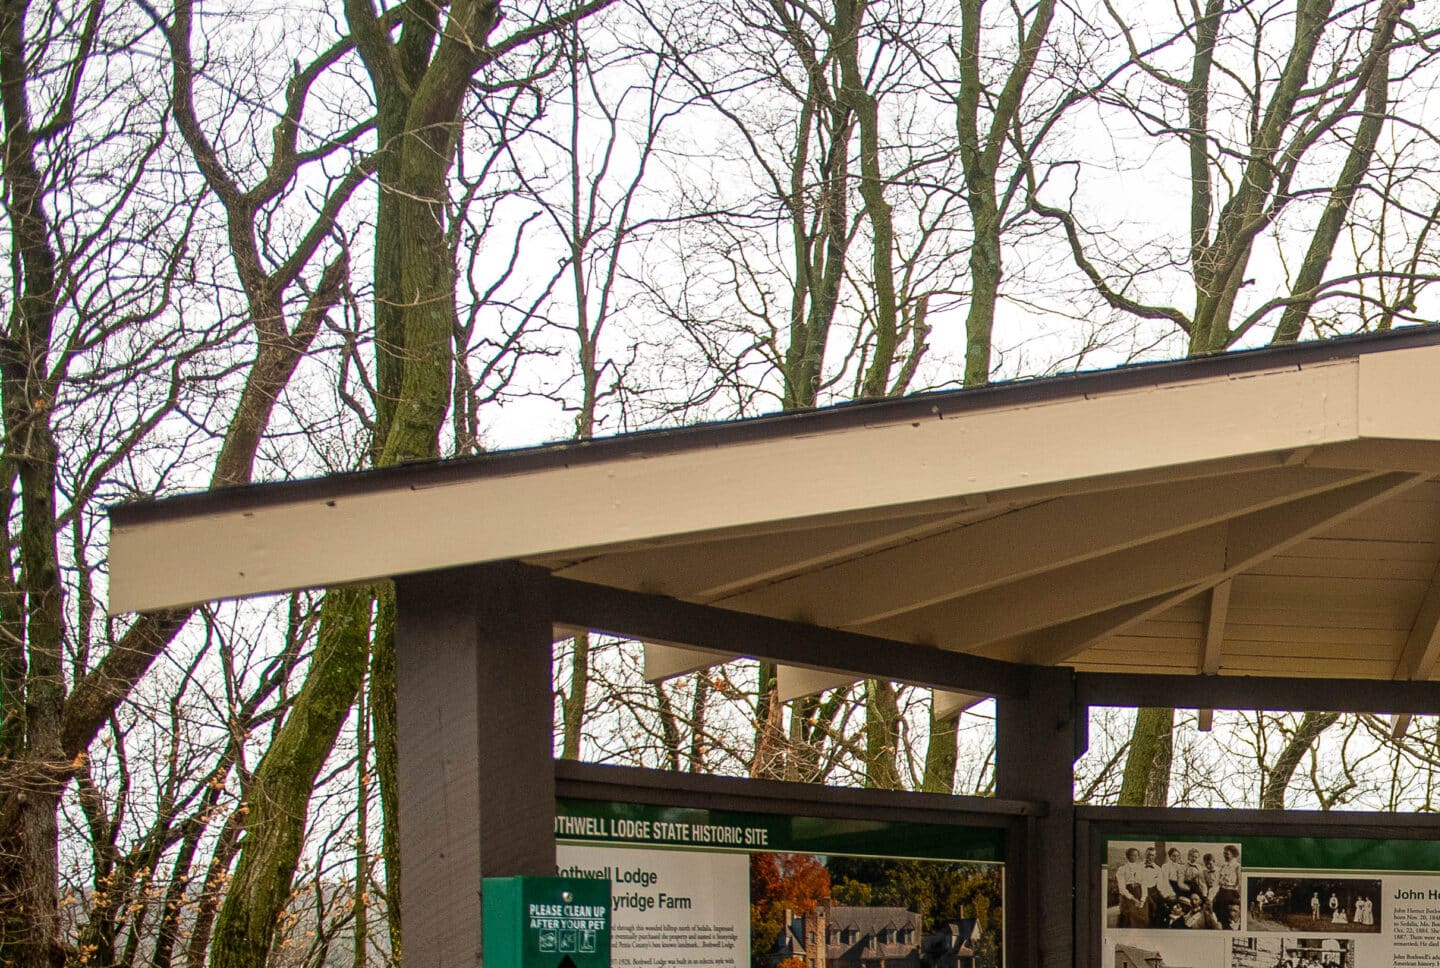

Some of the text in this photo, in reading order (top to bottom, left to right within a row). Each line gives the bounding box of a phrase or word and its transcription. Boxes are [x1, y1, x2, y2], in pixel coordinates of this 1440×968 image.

[554, 815, 768, 846] THWELL LODGE STATE HISTORIC SITE
[555, 865, 658, 888] othwell Lodge
[612, 893, 692, 911] yridge Farm
[1394, 889, 1424, 900] John
[529, 903, 606, 918] PLEASE CLEAN UP
[529, 918, 606, 930] AFTER YOUR PET
